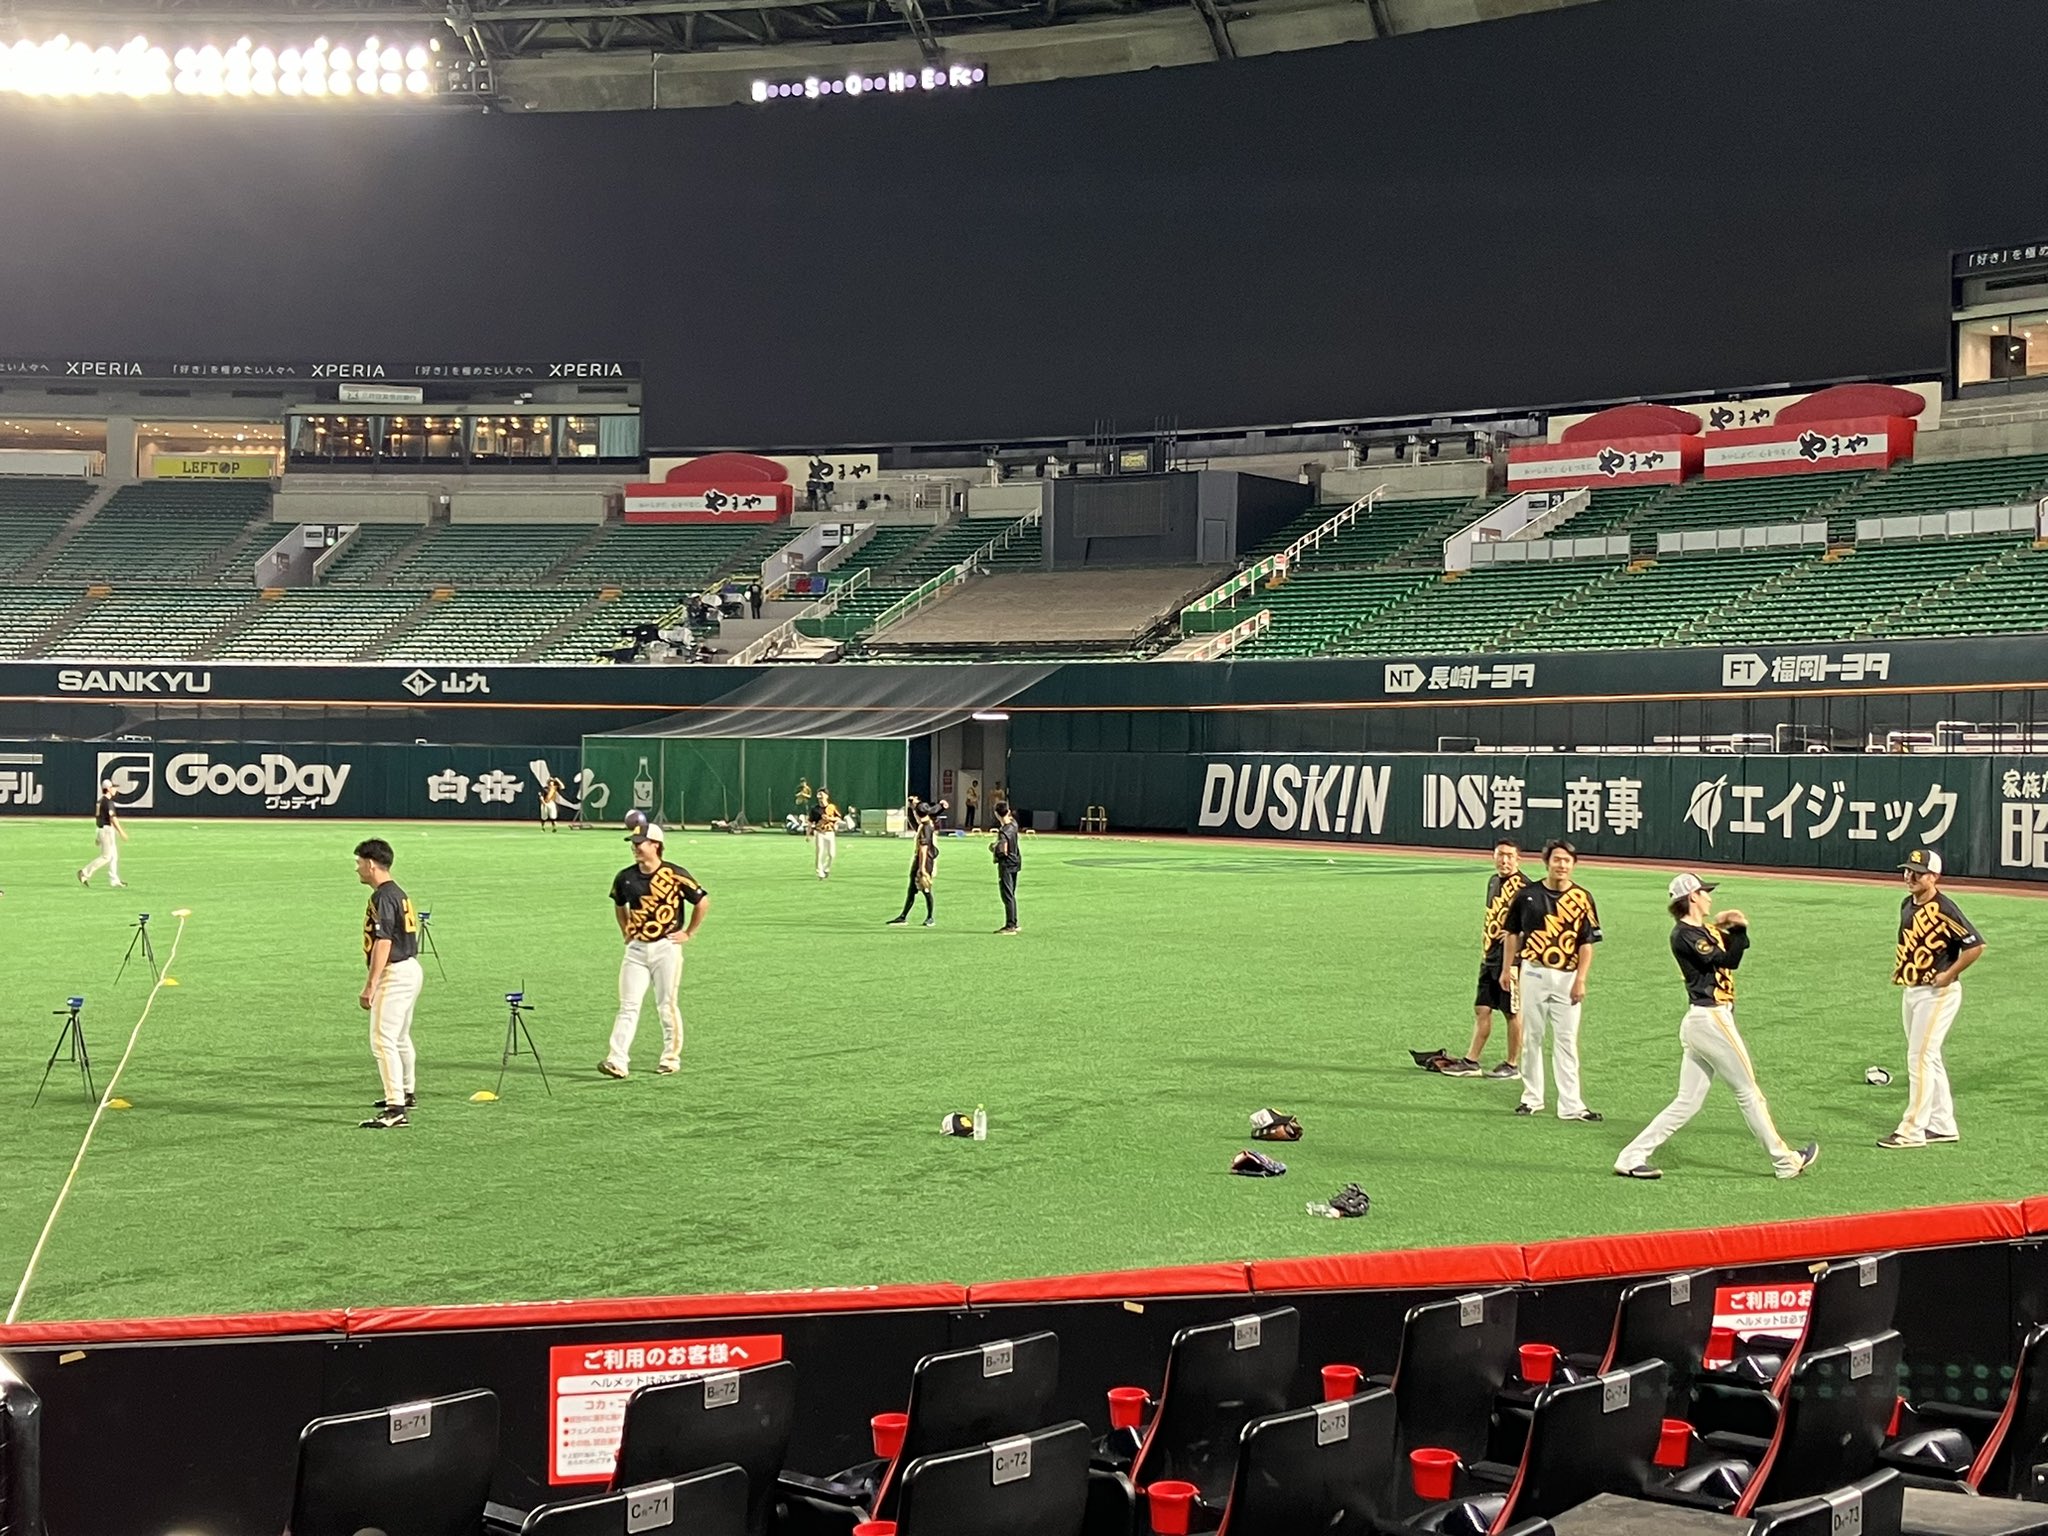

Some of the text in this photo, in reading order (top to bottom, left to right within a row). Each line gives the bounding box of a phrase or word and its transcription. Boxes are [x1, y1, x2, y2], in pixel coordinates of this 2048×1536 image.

[66, 362, 142, 376] XPERIA
[311, 363, 384, 377] XPERIA
[549, 363, 623, 377] XPERIA
[1389, 664, 1536, 690] NT 長崎トヨタ
[1730, 653, 1891, 683] FT 福岡トヨタ
[58, 670, 211, 693] SANKYU
[442, 672, 490, 693] 山九
[1490, 775, 1643, 836] 第一商事
[1729, 781, 1958, 844] エイジェック
[584, 1343, 748, 1370] ご利用のお客様へ
